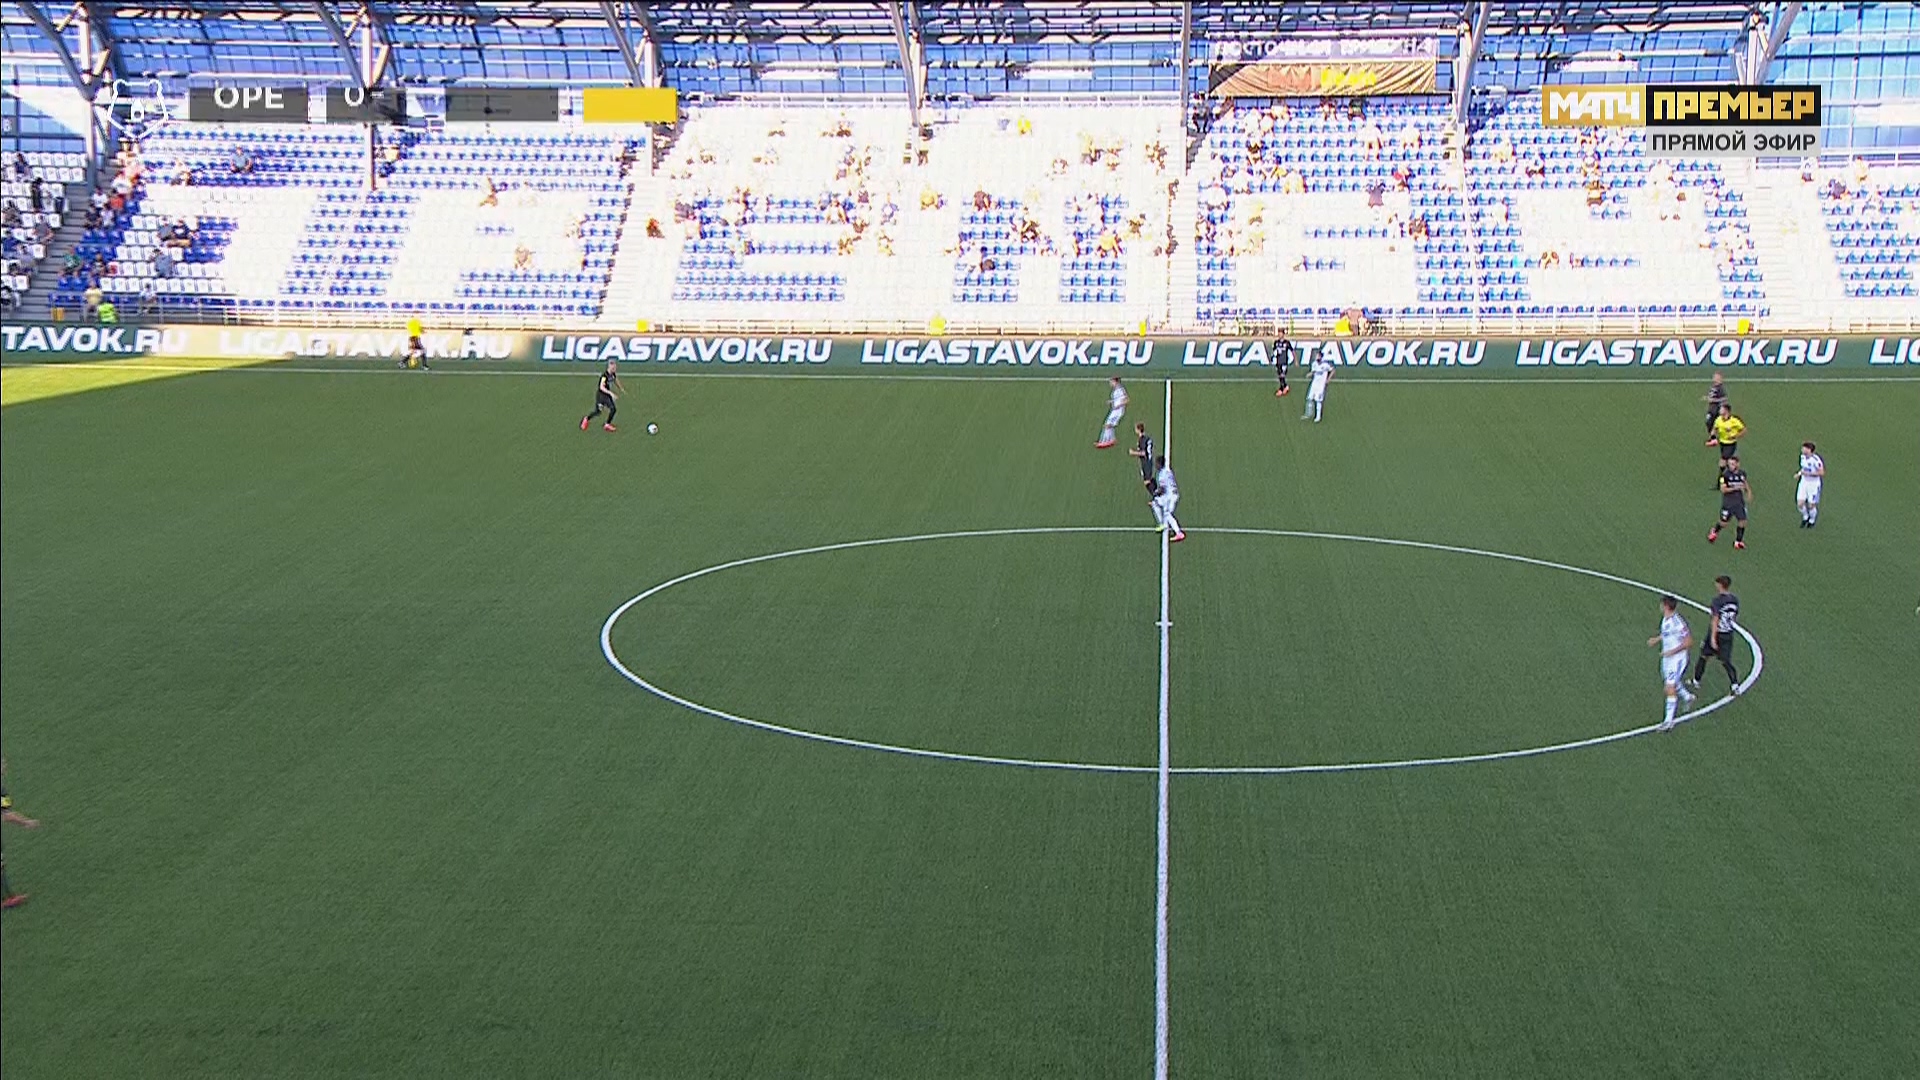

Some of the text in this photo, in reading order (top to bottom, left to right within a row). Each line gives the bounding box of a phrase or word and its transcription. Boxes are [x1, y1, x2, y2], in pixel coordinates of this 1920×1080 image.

[541, 336, 833, 364] LIGASTAVOK.RU
[860, 338, 1154, 365] LIGASTAVOK.RU
[1516, 338, 1838, 365] LIGASTAVOK.RU
